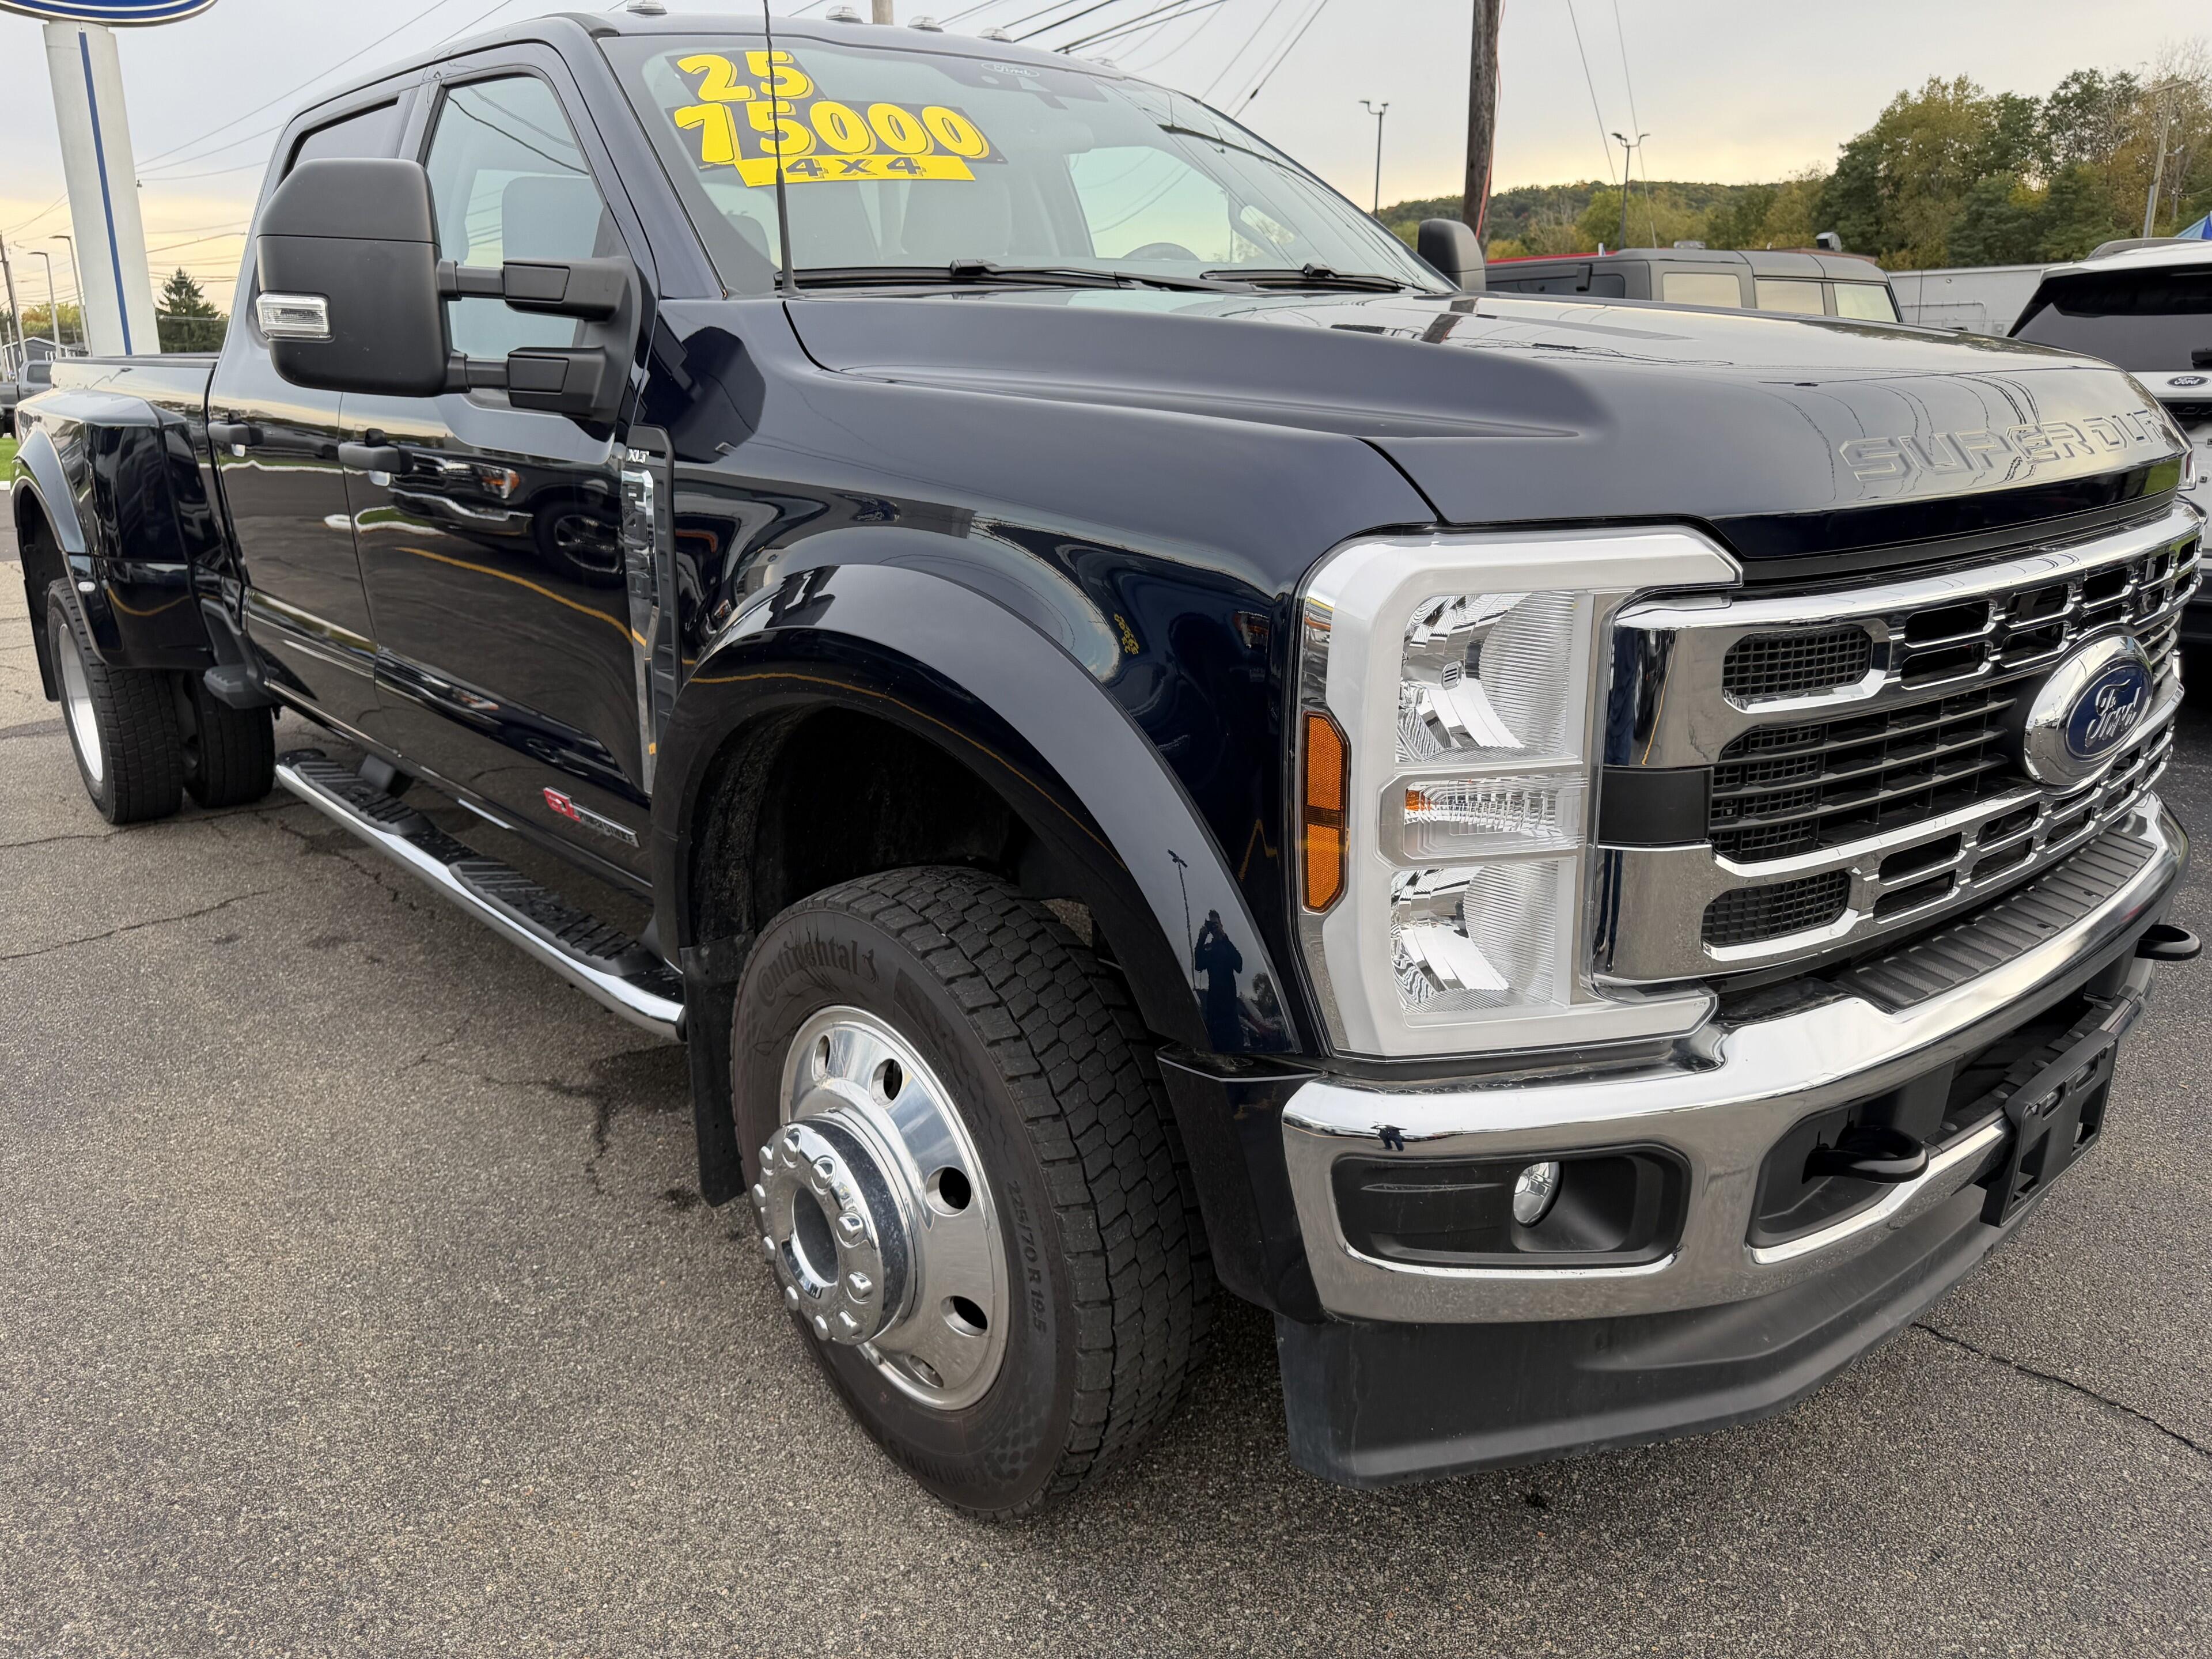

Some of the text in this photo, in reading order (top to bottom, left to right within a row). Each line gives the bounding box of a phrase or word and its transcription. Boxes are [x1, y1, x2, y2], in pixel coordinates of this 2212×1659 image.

[677, 51, 814, 103] 25
[627, 448, 650, 464] XLT
[1838, 421, 2094, 483] SUPER
[2085, 678, 2143, 748] Ford
[756, 935, 859, 1008] Continental
[1006, 1179, 1047, 1335] 225/70 R 19.5
